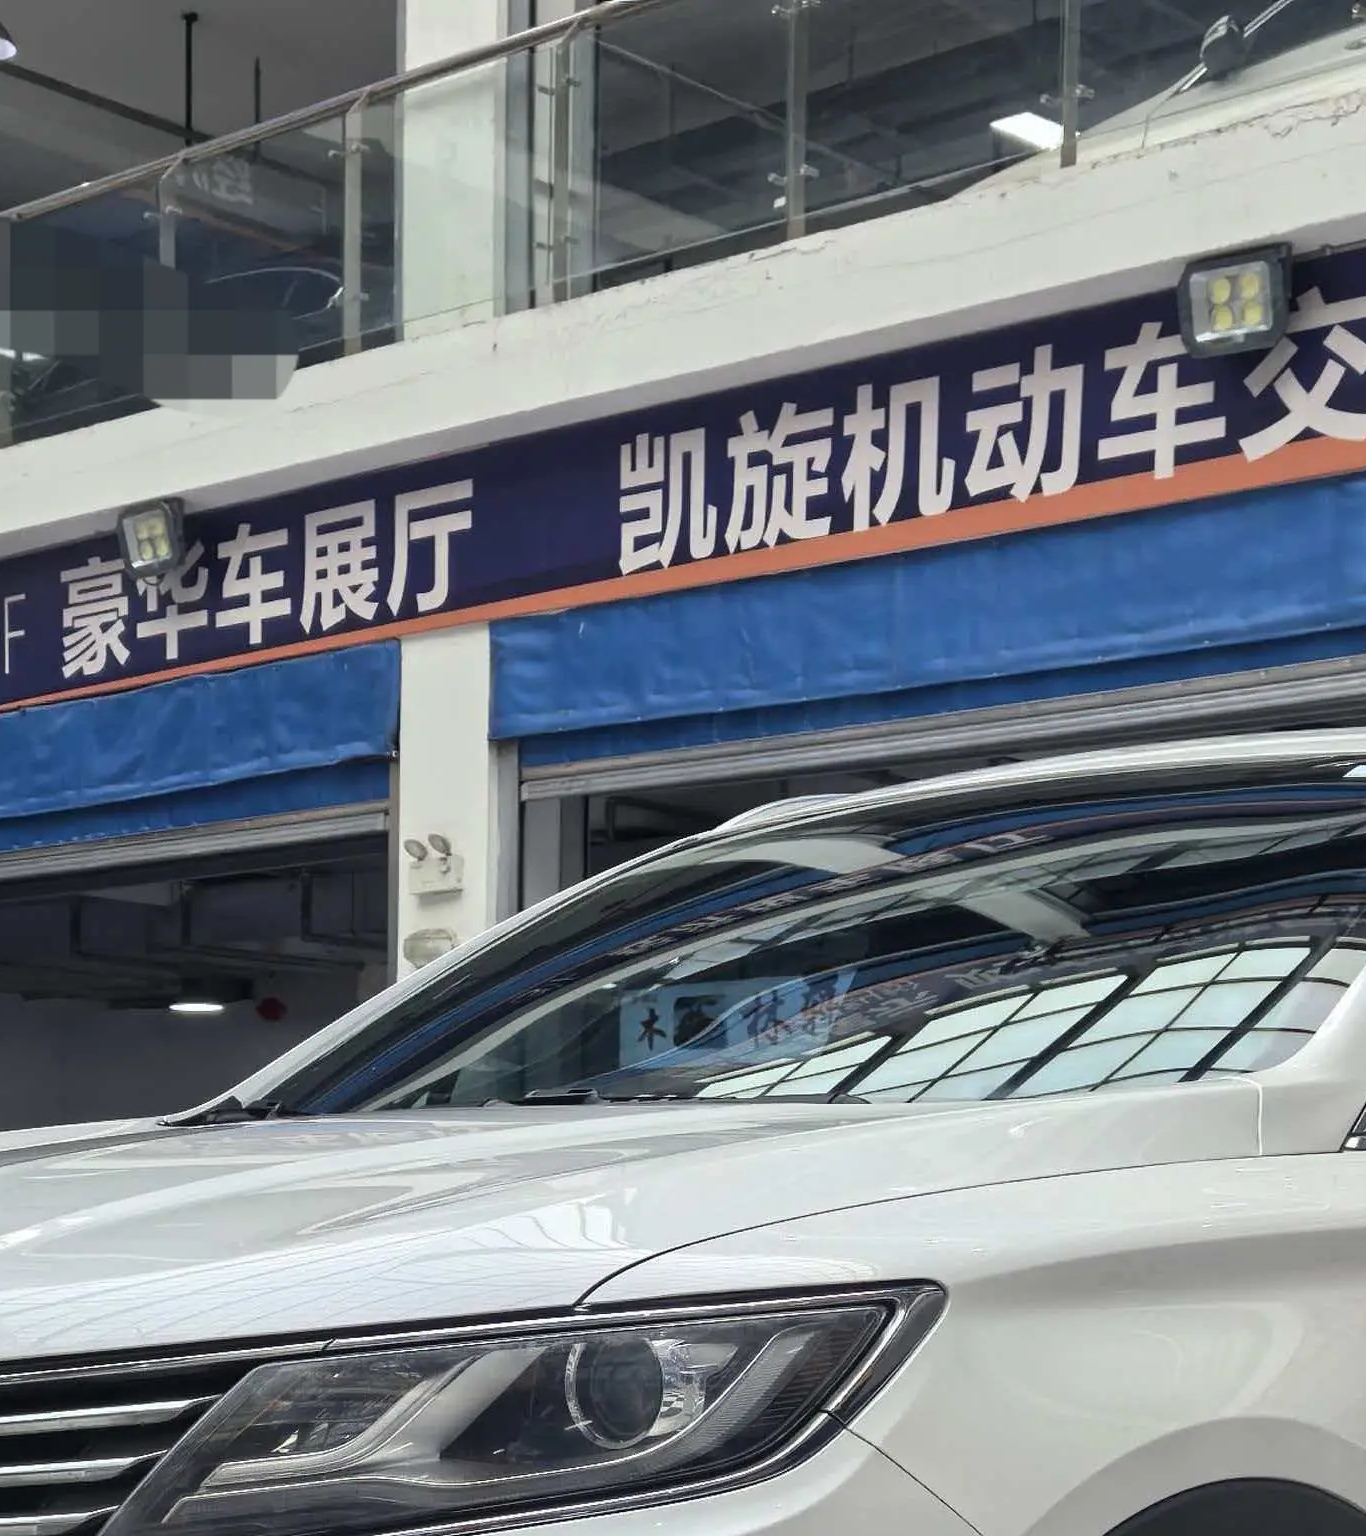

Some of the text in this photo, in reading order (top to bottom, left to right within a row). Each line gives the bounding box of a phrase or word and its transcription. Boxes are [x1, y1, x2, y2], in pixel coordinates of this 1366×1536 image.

[60, 478, 474, 680] 豪华车展厅
